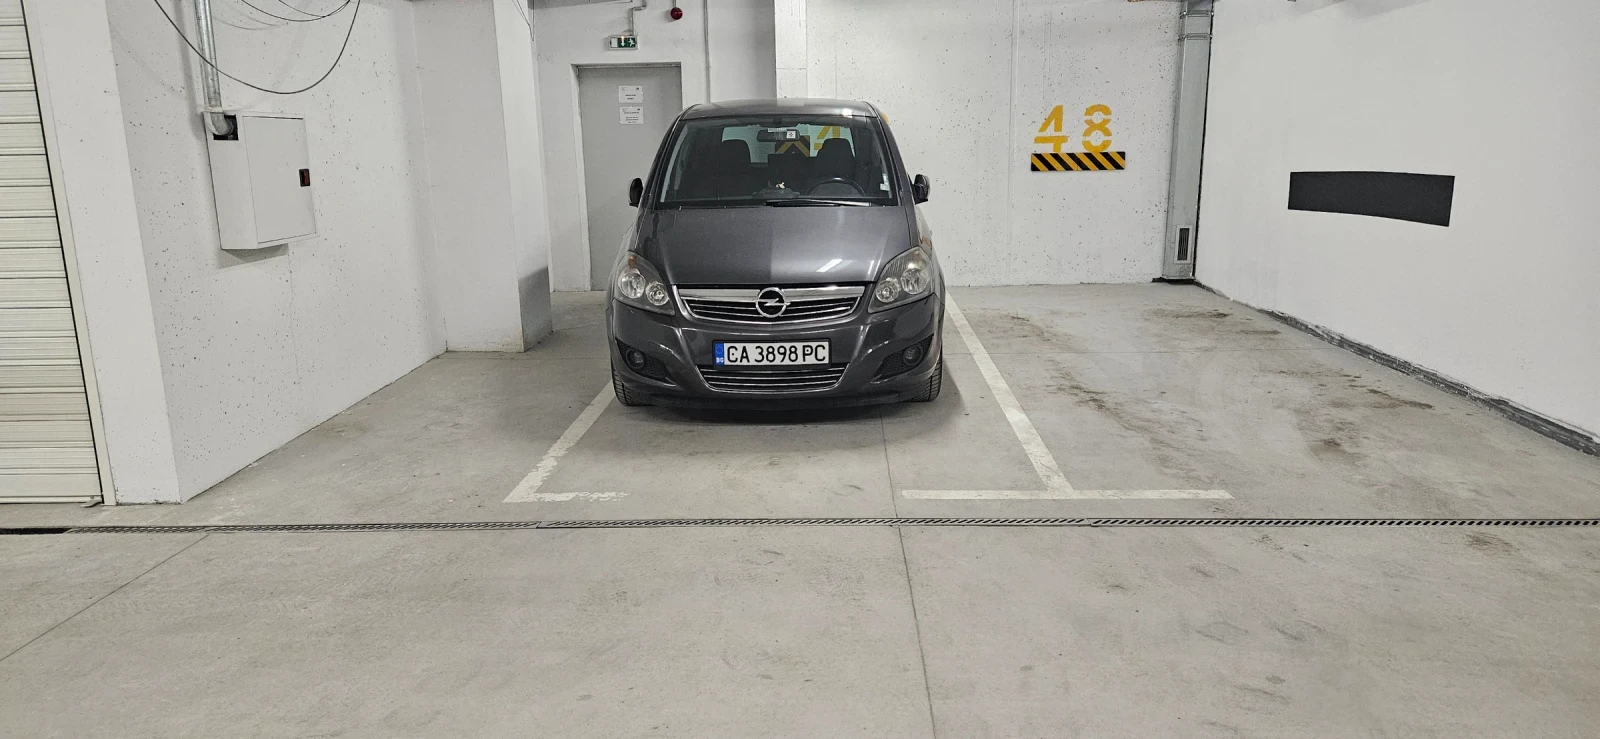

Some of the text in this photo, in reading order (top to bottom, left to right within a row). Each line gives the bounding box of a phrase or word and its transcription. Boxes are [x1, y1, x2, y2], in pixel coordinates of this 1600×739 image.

[1034, 104, 1112, 152] 48
[727, 344, 826, 363] CA 3898 PC
